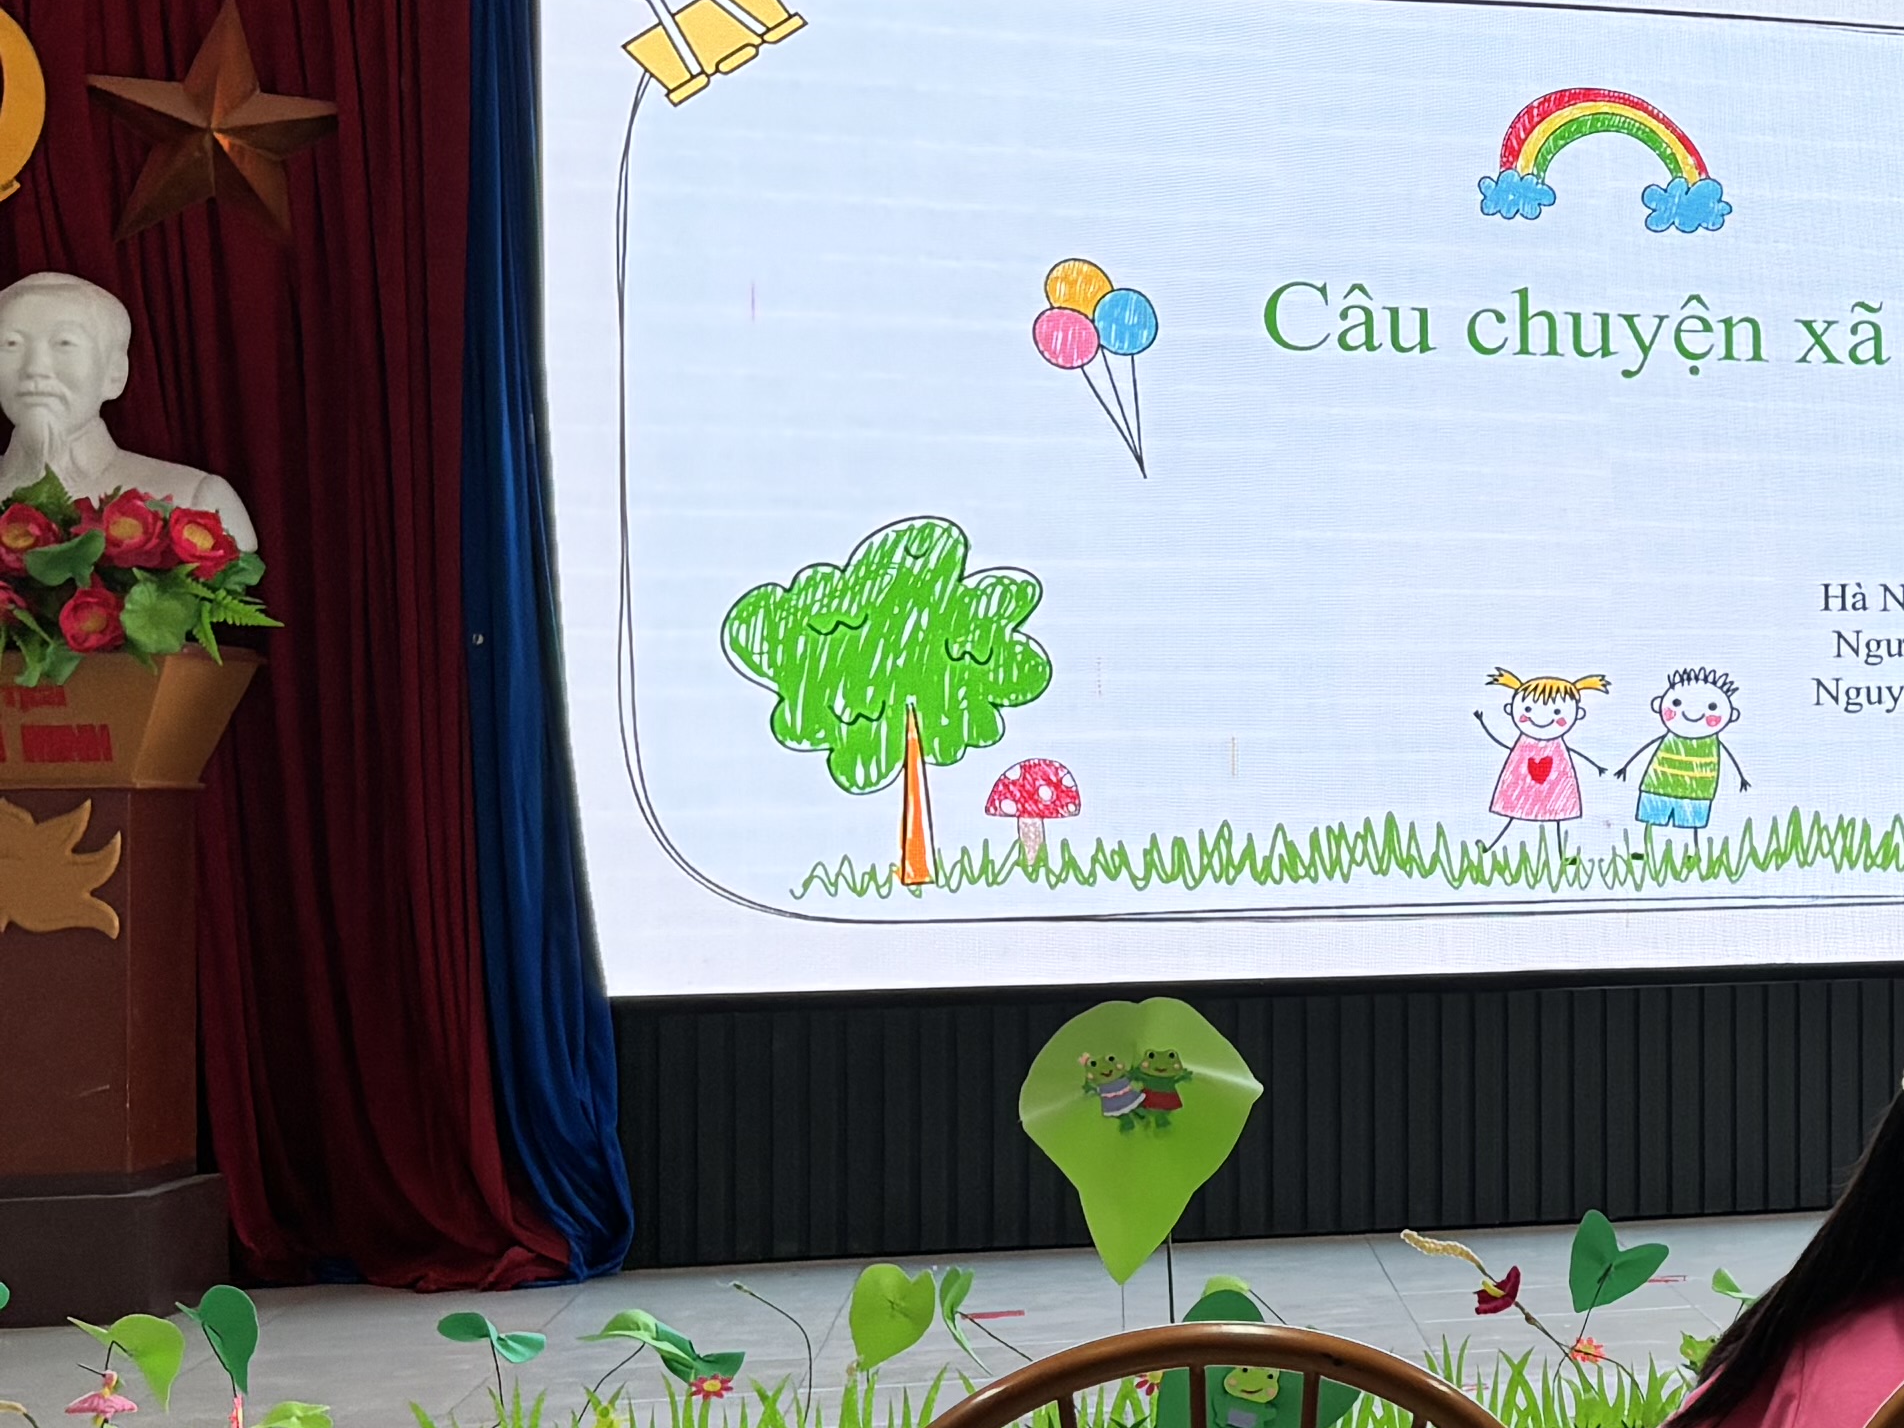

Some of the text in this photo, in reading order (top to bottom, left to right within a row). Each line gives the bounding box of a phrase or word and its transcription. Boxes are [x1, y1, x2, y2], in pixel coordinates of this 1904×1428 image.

[1263, 281, 1432, 355] Câu
[1467, 286, 1767, 379] chuyện
[1795, 301, 1892, 368] xã
[1820, 582, 1869, 612] Hà
